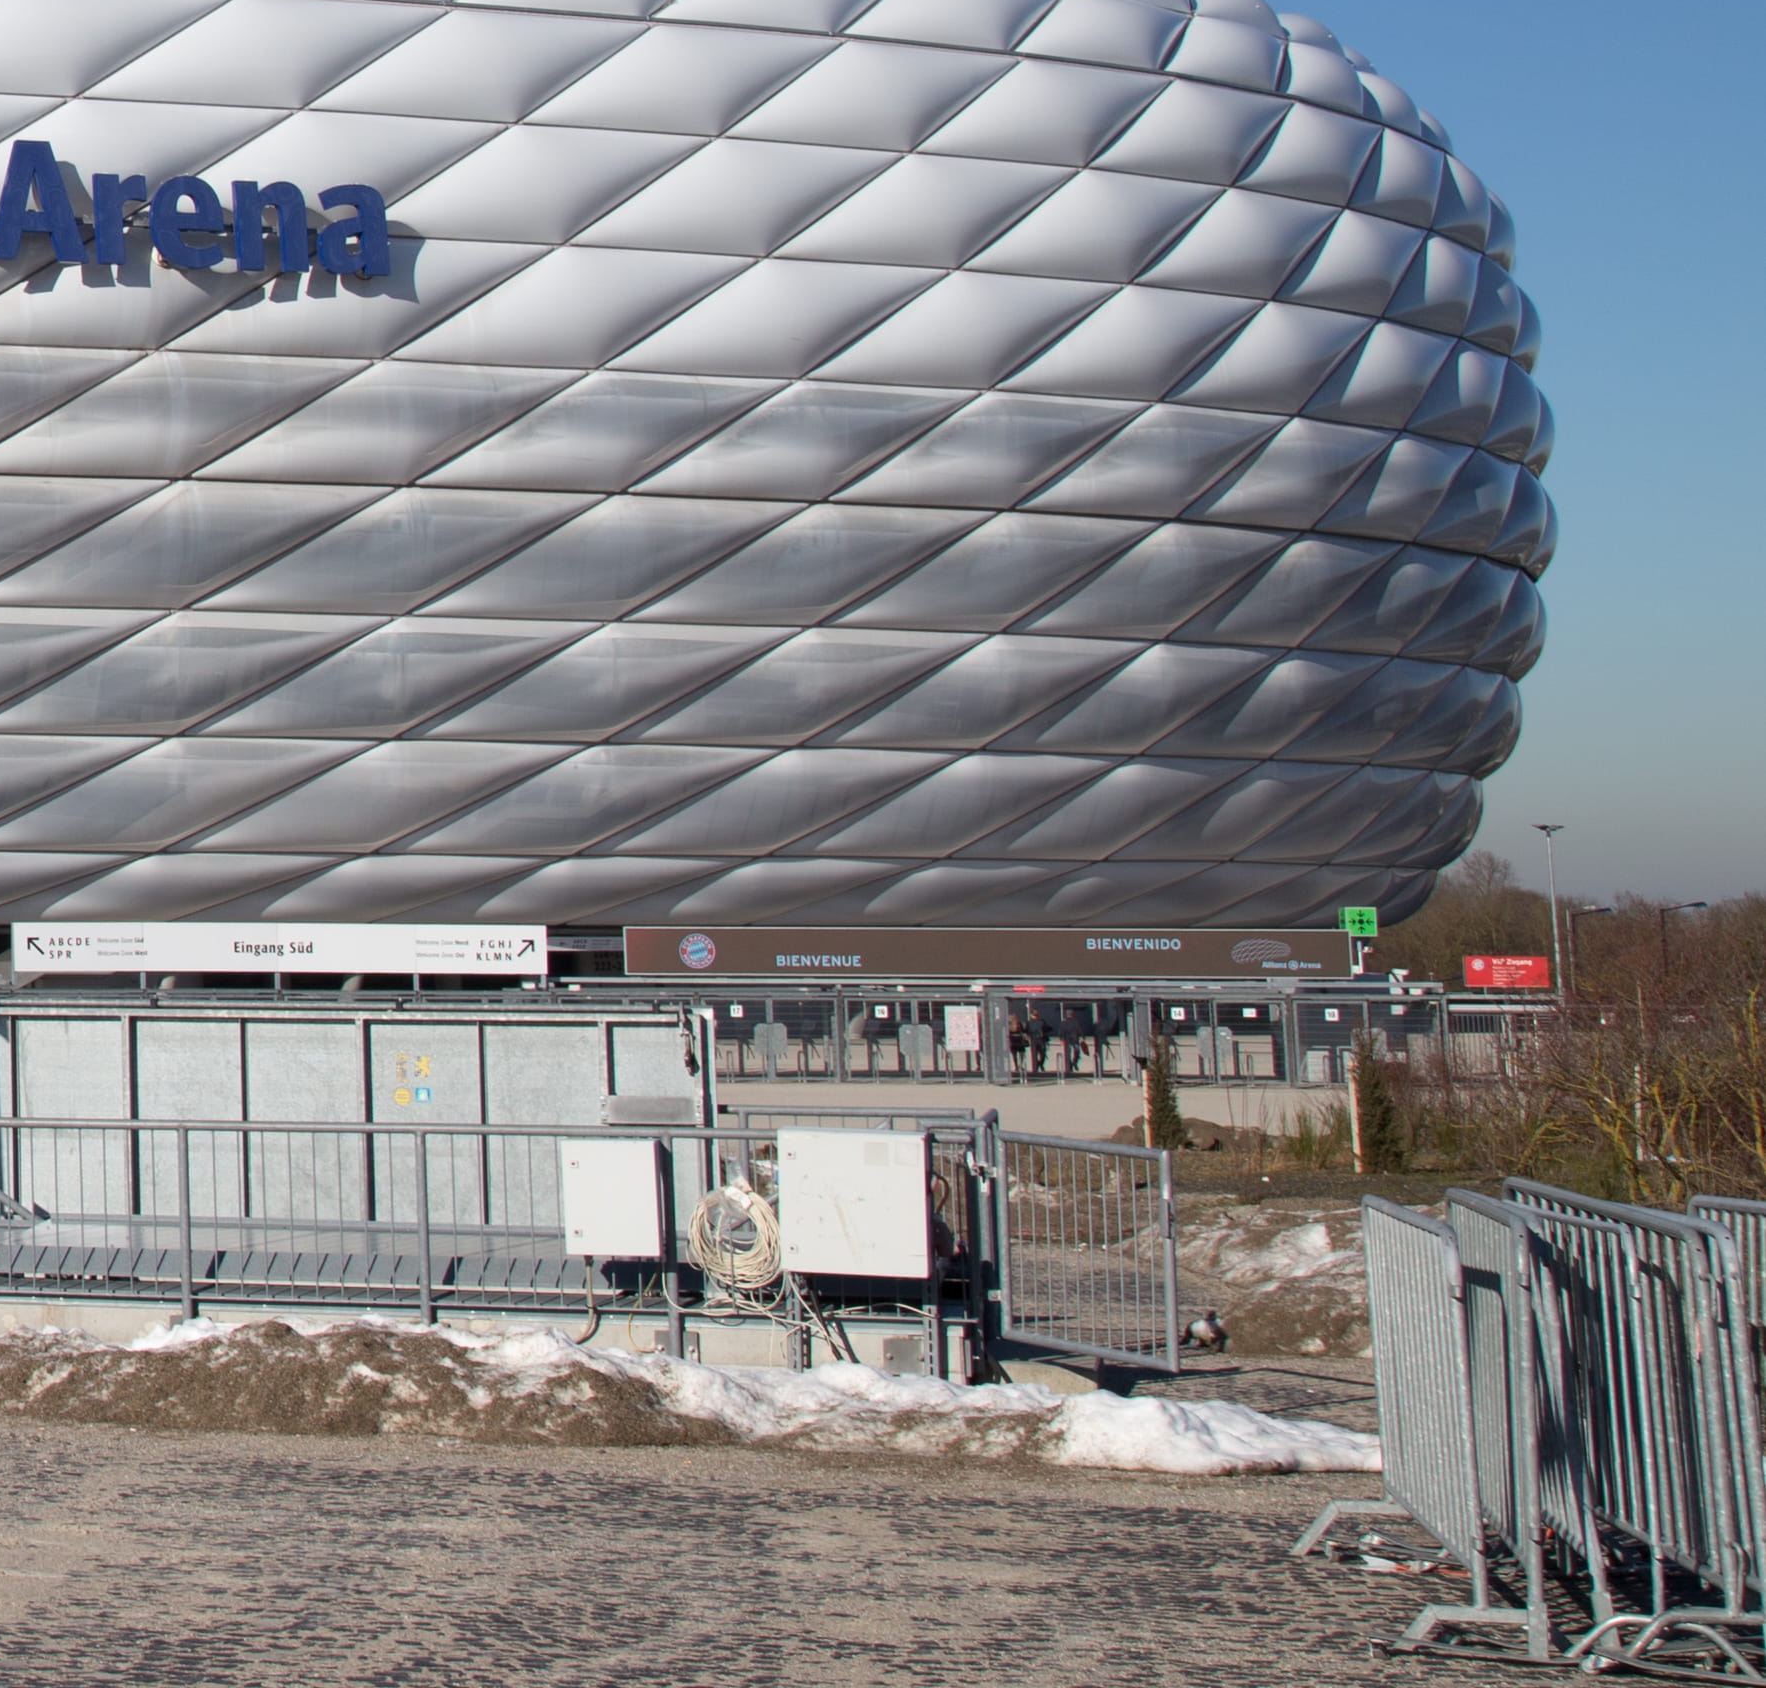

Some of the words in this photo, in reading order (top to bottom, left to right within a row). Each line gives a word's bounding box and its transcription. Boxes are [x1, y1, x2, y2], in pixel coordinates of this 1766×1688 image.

[233, 941, 284, 957] Eingang
[289, 941, 313, 953] Süd
[1086, 938, 1182, 951] BIENVENIDO
[775, 955, 862, 967] BIENVENUE
